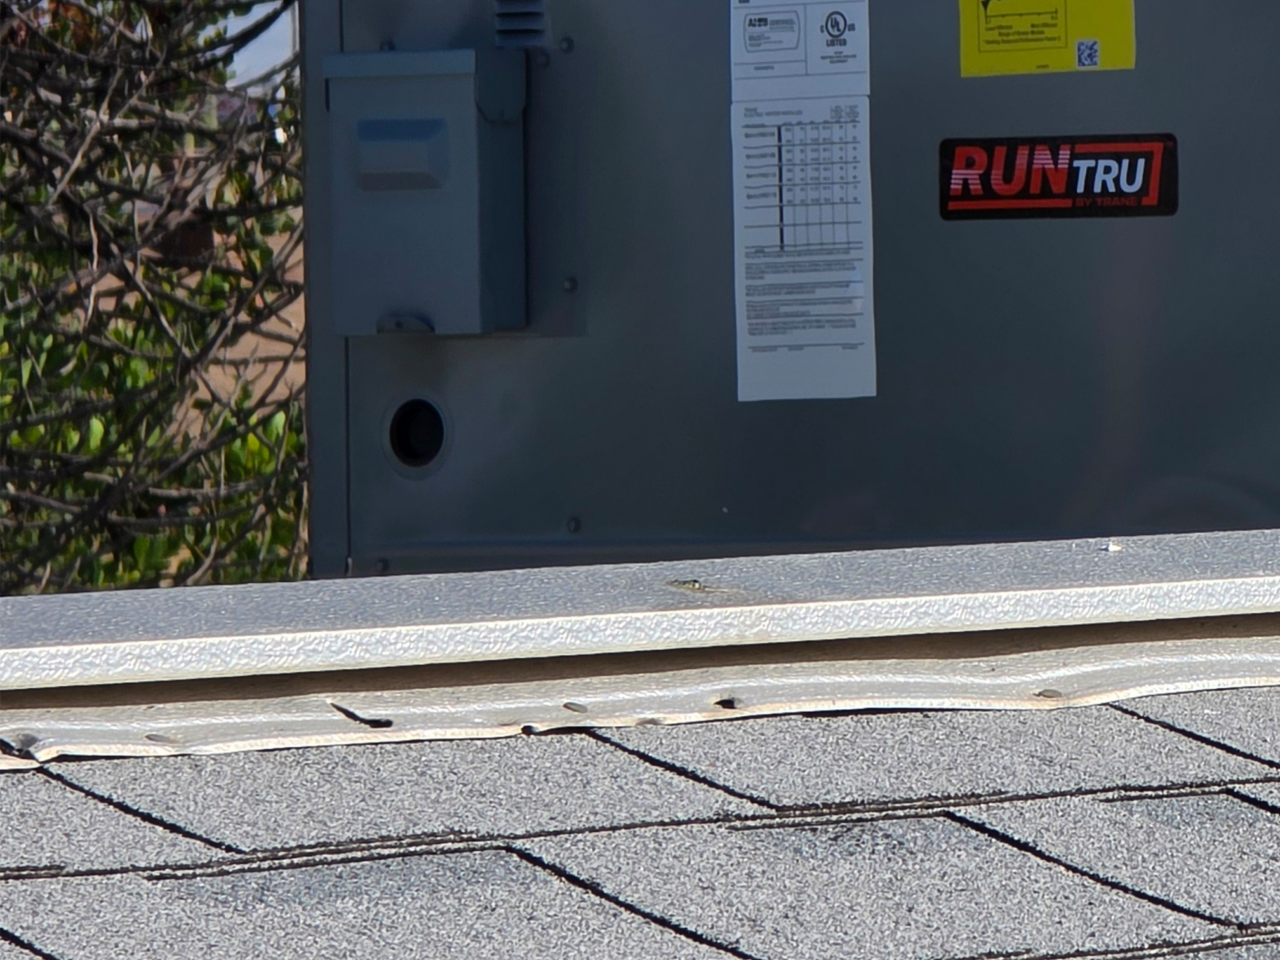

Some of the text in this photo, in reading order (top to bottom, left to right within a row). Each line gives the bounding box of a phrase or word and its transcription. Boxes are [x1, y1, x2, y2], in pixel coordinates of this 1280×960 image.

[826, 38, 847, 47] LISTED
[1076, 197, 1137, 207] BY TRANE
